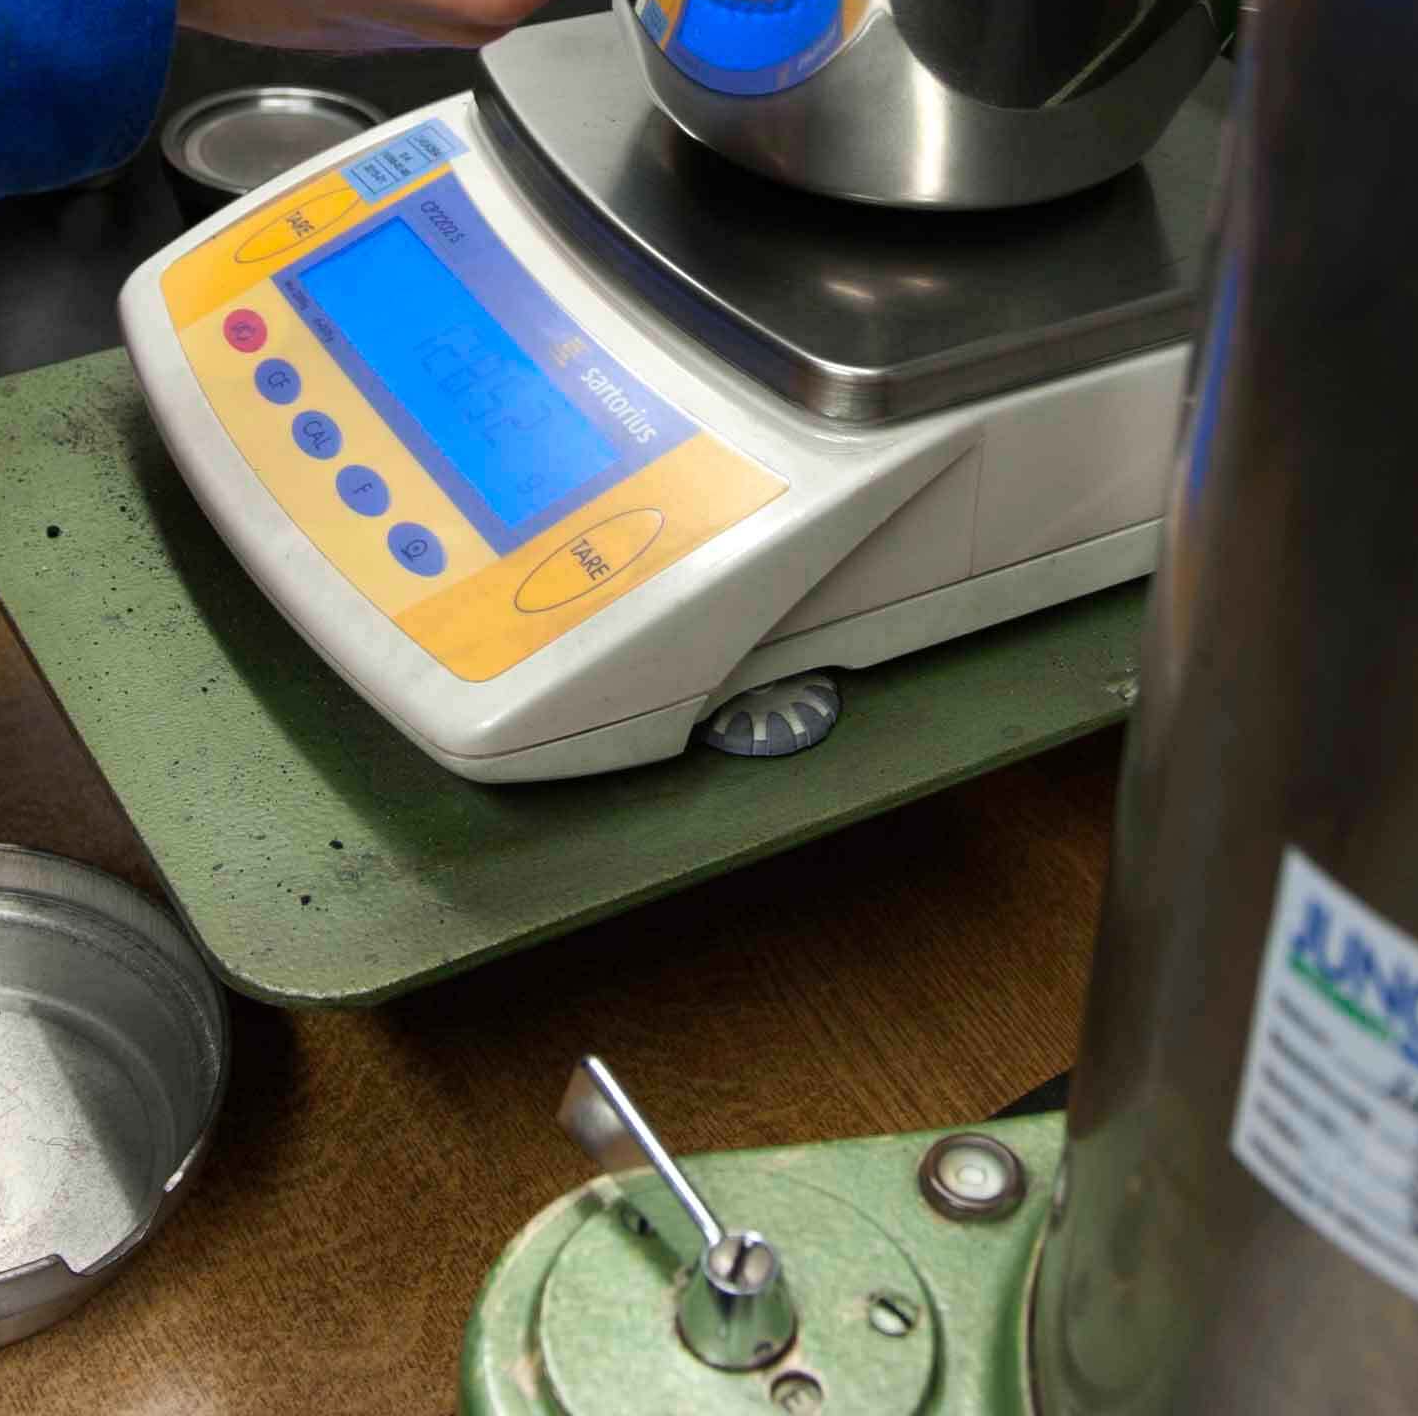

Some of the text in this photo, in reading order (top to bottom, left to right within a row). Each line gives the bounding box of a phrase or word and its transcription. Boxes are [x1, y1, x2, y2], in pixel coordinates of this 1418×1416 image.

[286, 210, 316, 237] TARE
[581, 367, 658, 444] sartorius
[302, 420, 331, 451] CAL
[570, 538, 611, 581] TARE
